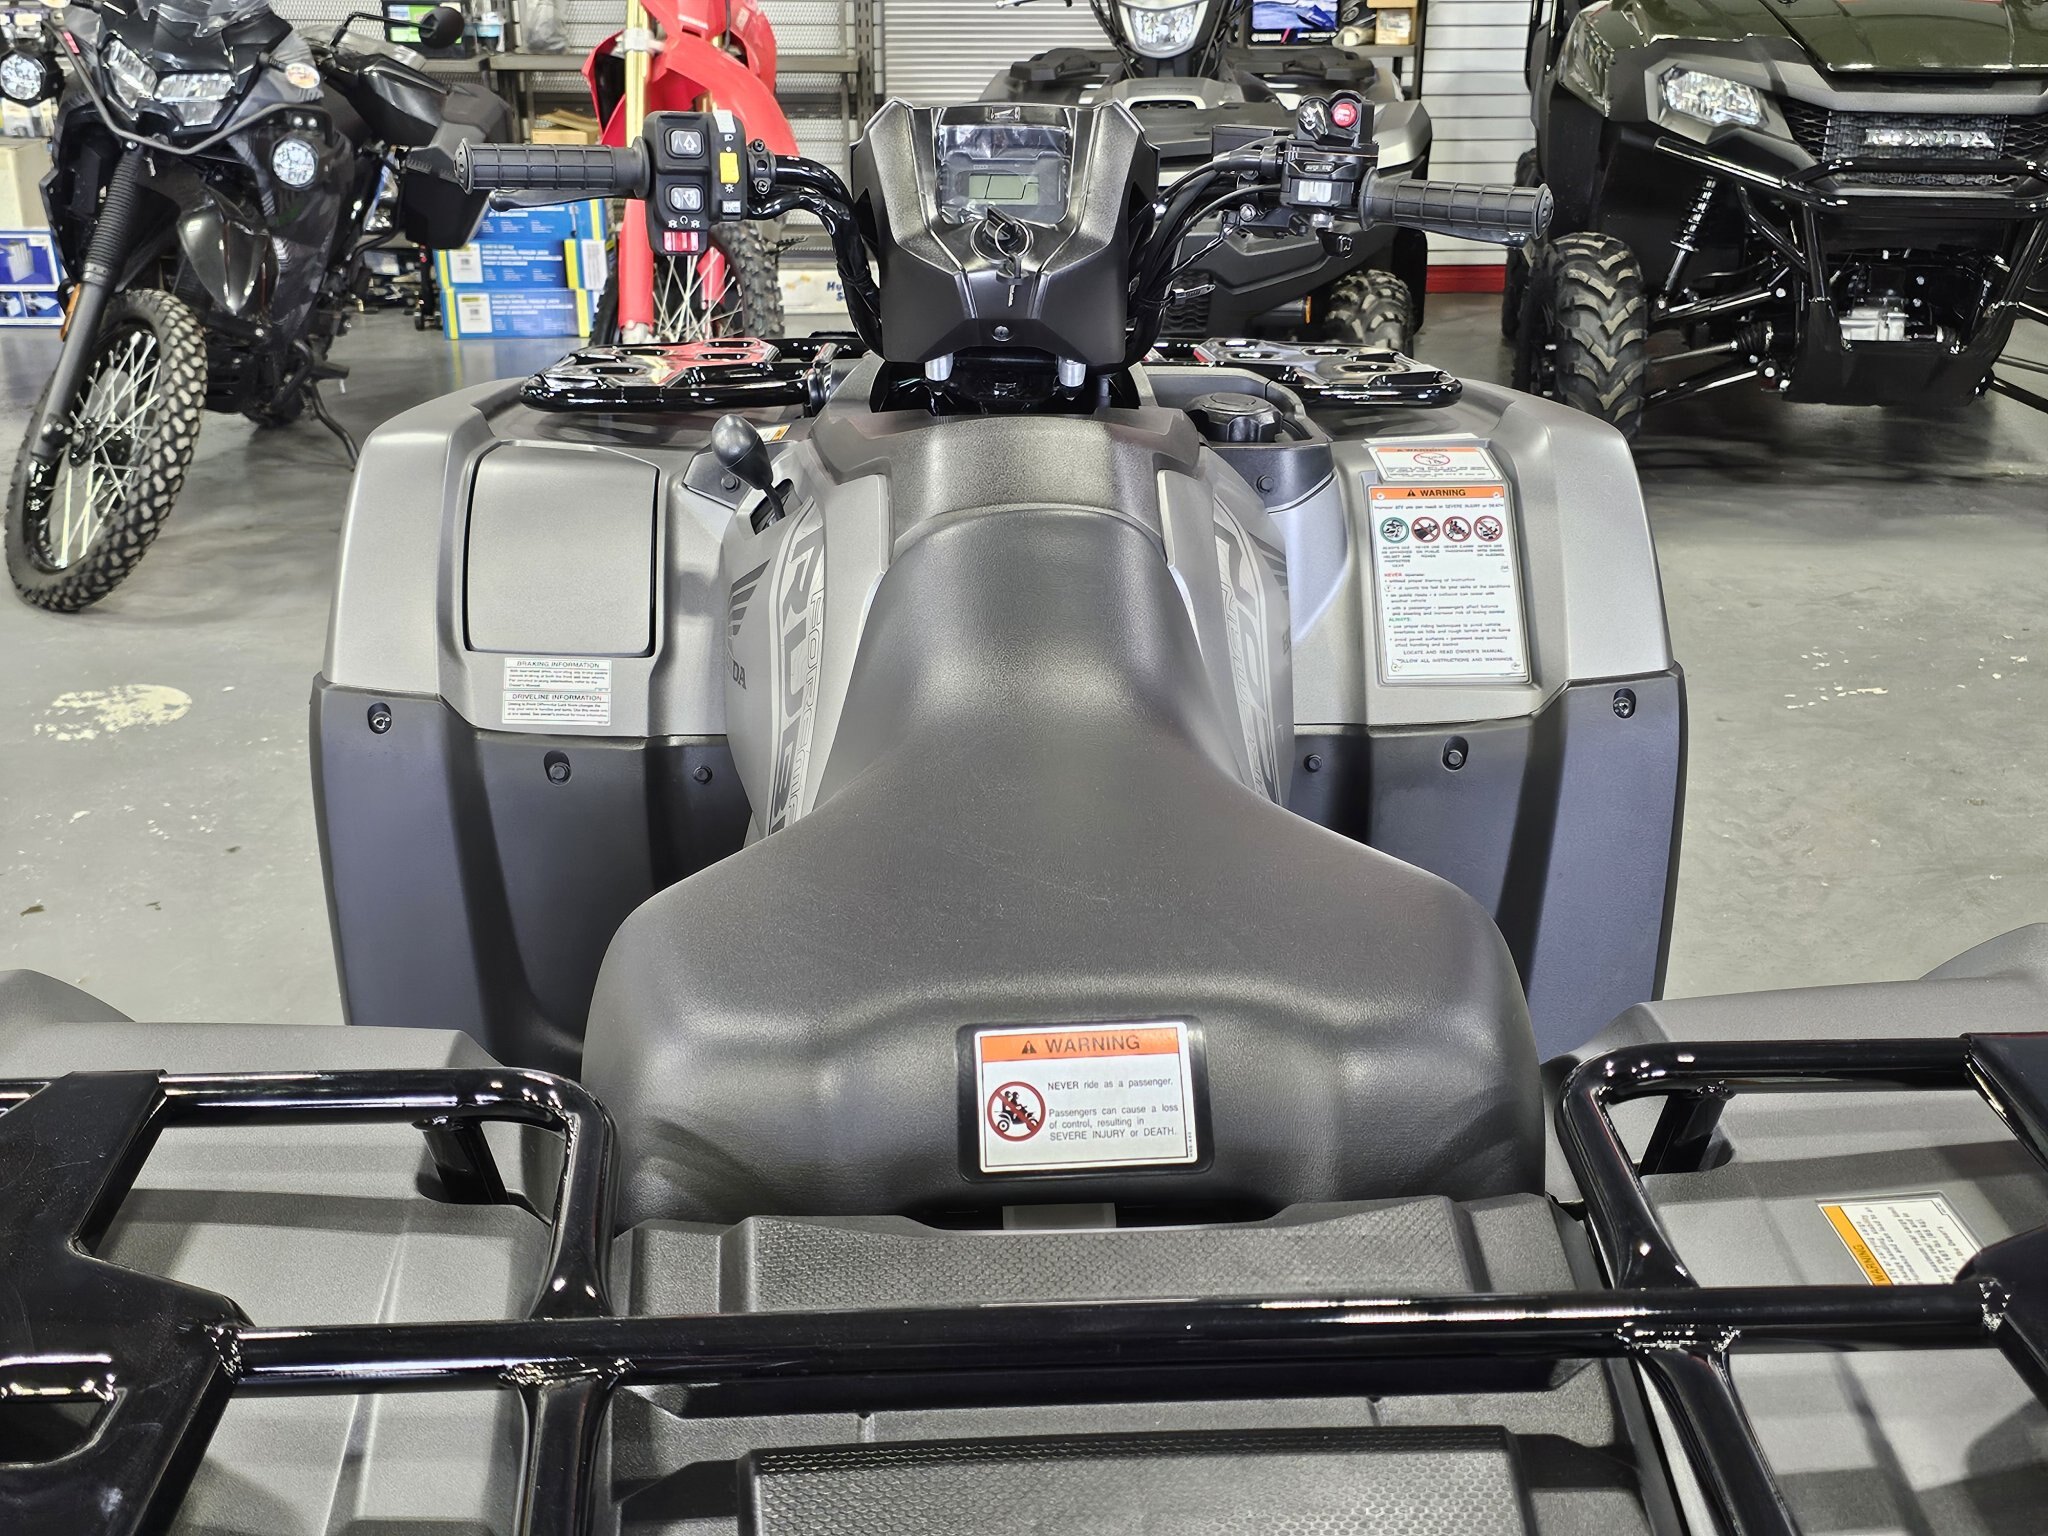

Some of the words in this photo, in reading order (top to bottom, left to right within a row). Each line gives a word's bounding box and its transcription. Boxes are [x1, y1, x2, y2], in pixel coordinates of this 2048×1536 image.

[1865, 128, 1995, 147] HONDA
[1420, 489, 1466, 497] WARNING
[516, 660, 550, 668] BRAKING
[551, 661, 600, 669] INFORMATION
[1045, 1035, 1140, 1054] WARNING
[1048, 1081, 1079, 1090] NEVER
[1084, 1080, 1098, 1089] ride
[1128, 1078, 1173, 1088] passenger.
[1049, 1108, 1097, 1118] Passengers
[1121, 1106, 1146, 1114] cause
[1151, 1105, 1156, 1113] a
[1162, 1104, 1178, 1112] loss
[1049, 1120, 1057, 1129] of
[1062, 1119, 1093, 1128] control,
[1097, 1118, 1132, 1127] resulting
[1137, 1117, 1144, 1125] in
[1050, 1131, 1087, 1141] SEVERE
[1093, 1129, 1125, 1139] INJURY
[1143, 1127, 1177, 1136] DEATH.
[1851, 1244, 1886, 1281] WARNING
